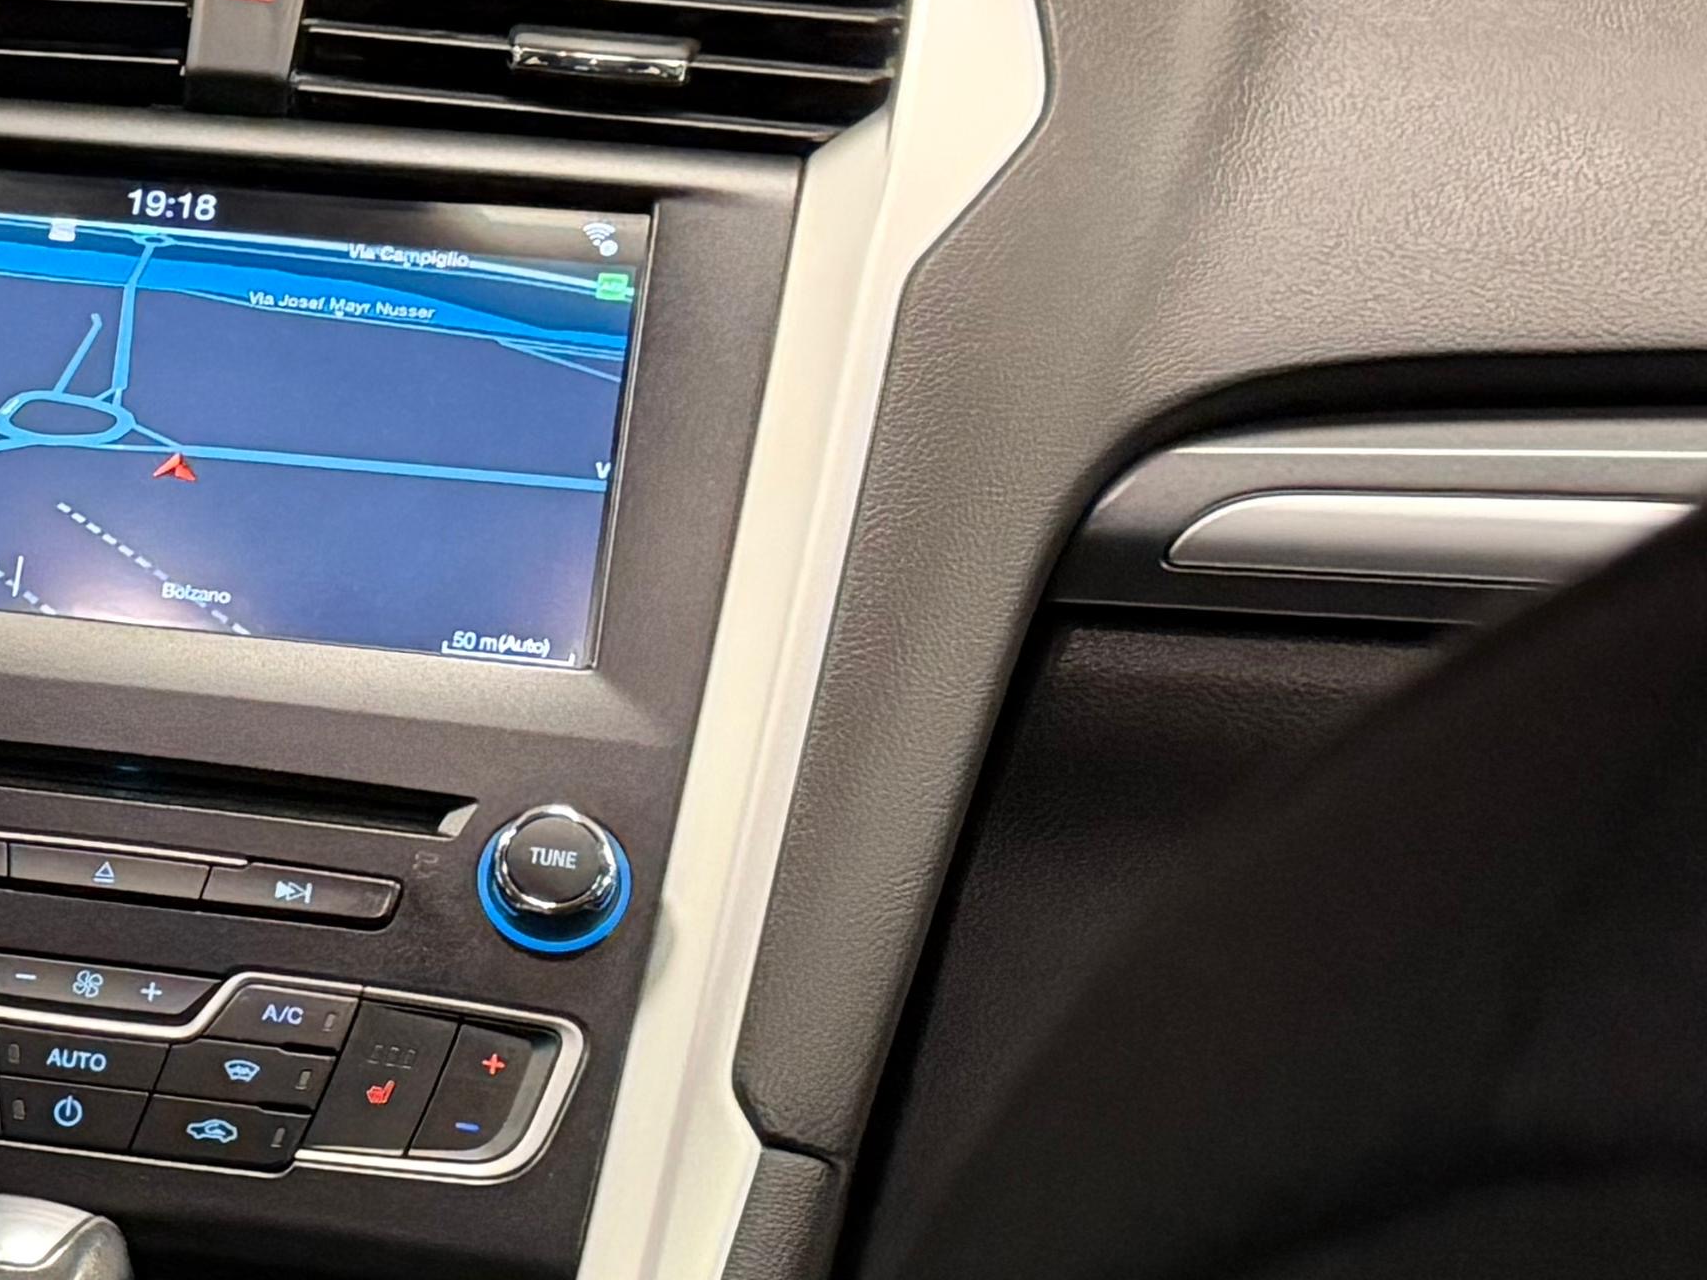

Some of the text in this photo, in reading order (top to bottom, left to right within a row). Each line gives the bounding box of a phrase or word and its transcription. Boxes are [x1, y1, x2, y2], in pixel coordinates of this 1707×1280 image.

[127, 187, 218, 224] 19:18
[348, 242, 471, 270] Via Campiglio
[248, 291, 437, 321] Via Josef Mayr Nusser
[161, 581, 232, 606] Bolzano
[452, 630, 477, 650] 50
[529, 845, 575, 871] TUNE
[261, 1003, 304, 1025] A/C
[46, 1047, 108, 1073] AUTO
